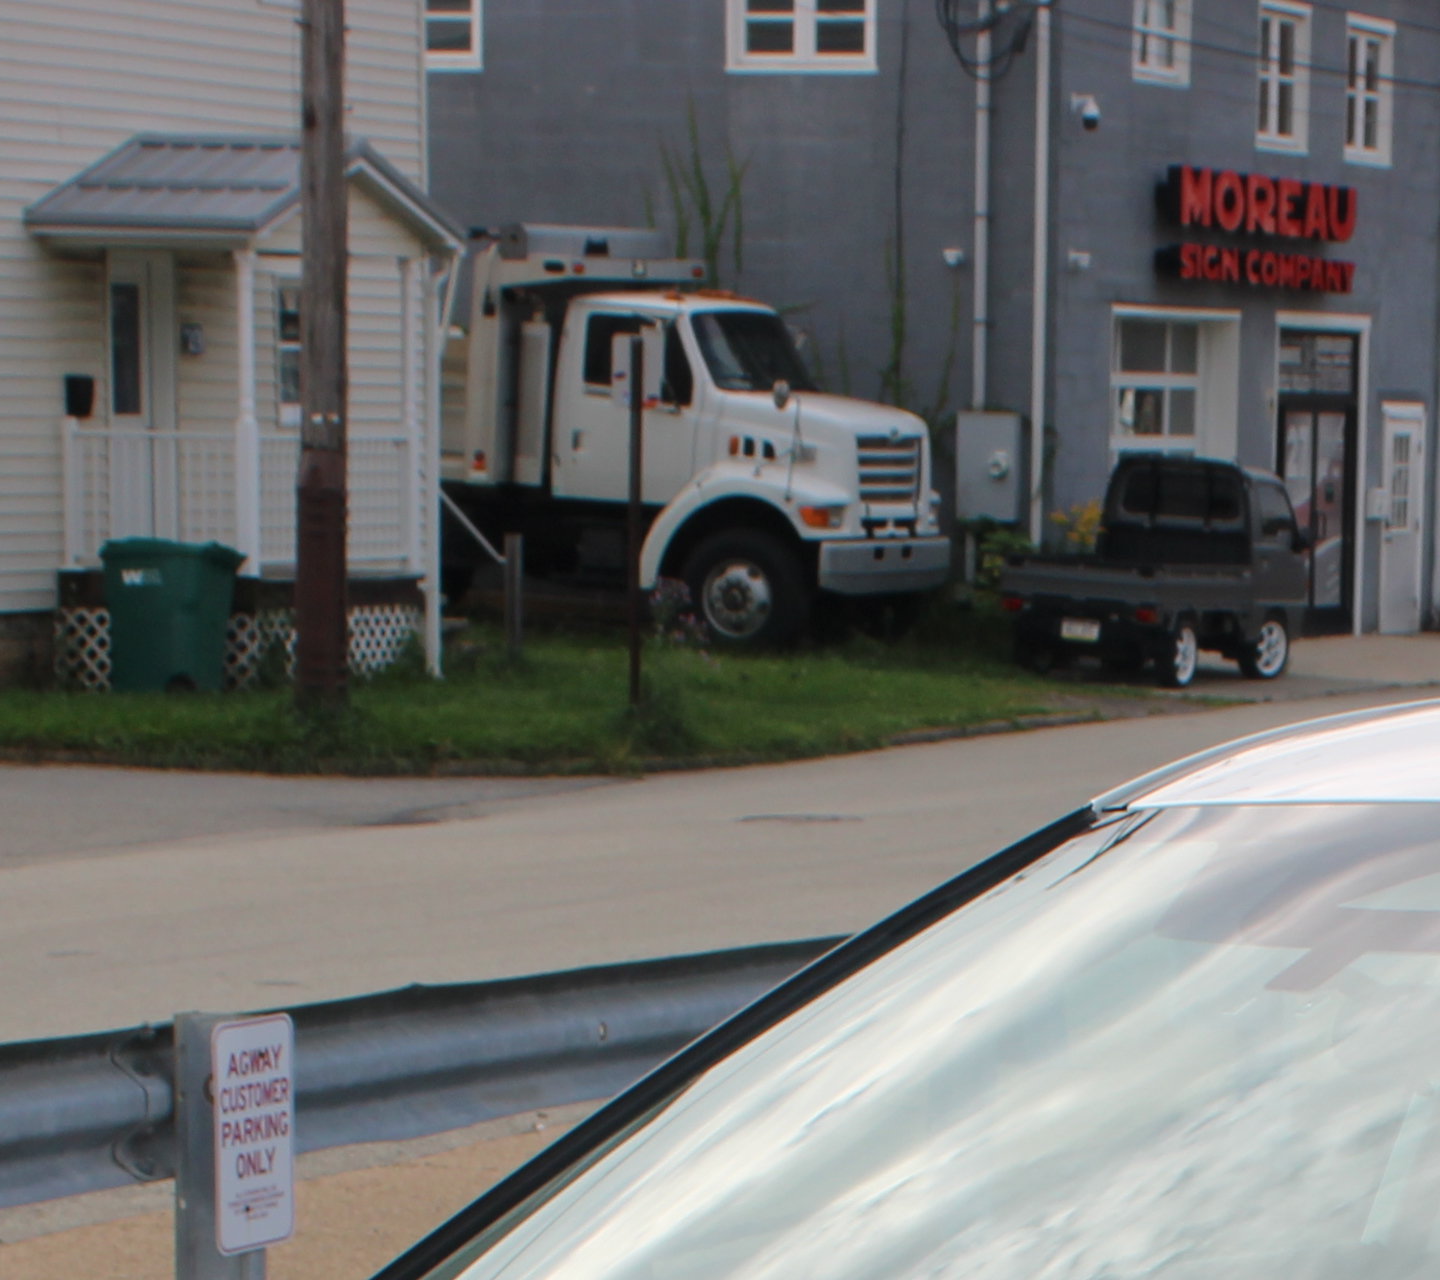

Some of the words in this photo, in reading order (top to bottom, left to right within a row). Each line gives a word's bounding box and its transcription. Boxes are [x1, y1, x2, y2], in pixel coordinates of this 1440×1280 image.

[1179, 164, 1357, 244] MOREAU
[1180, 242, 1241, 284] SIGN
[1246, 248, 1356, 294] COMPANY
[227, 1044, 283, 1078] AGWAY
[220, 1077, 290, 1114] CUSTOMER
[221, 1111, 290, 1148] PARKING
[235, 1147, 277, 1180] ONLY
